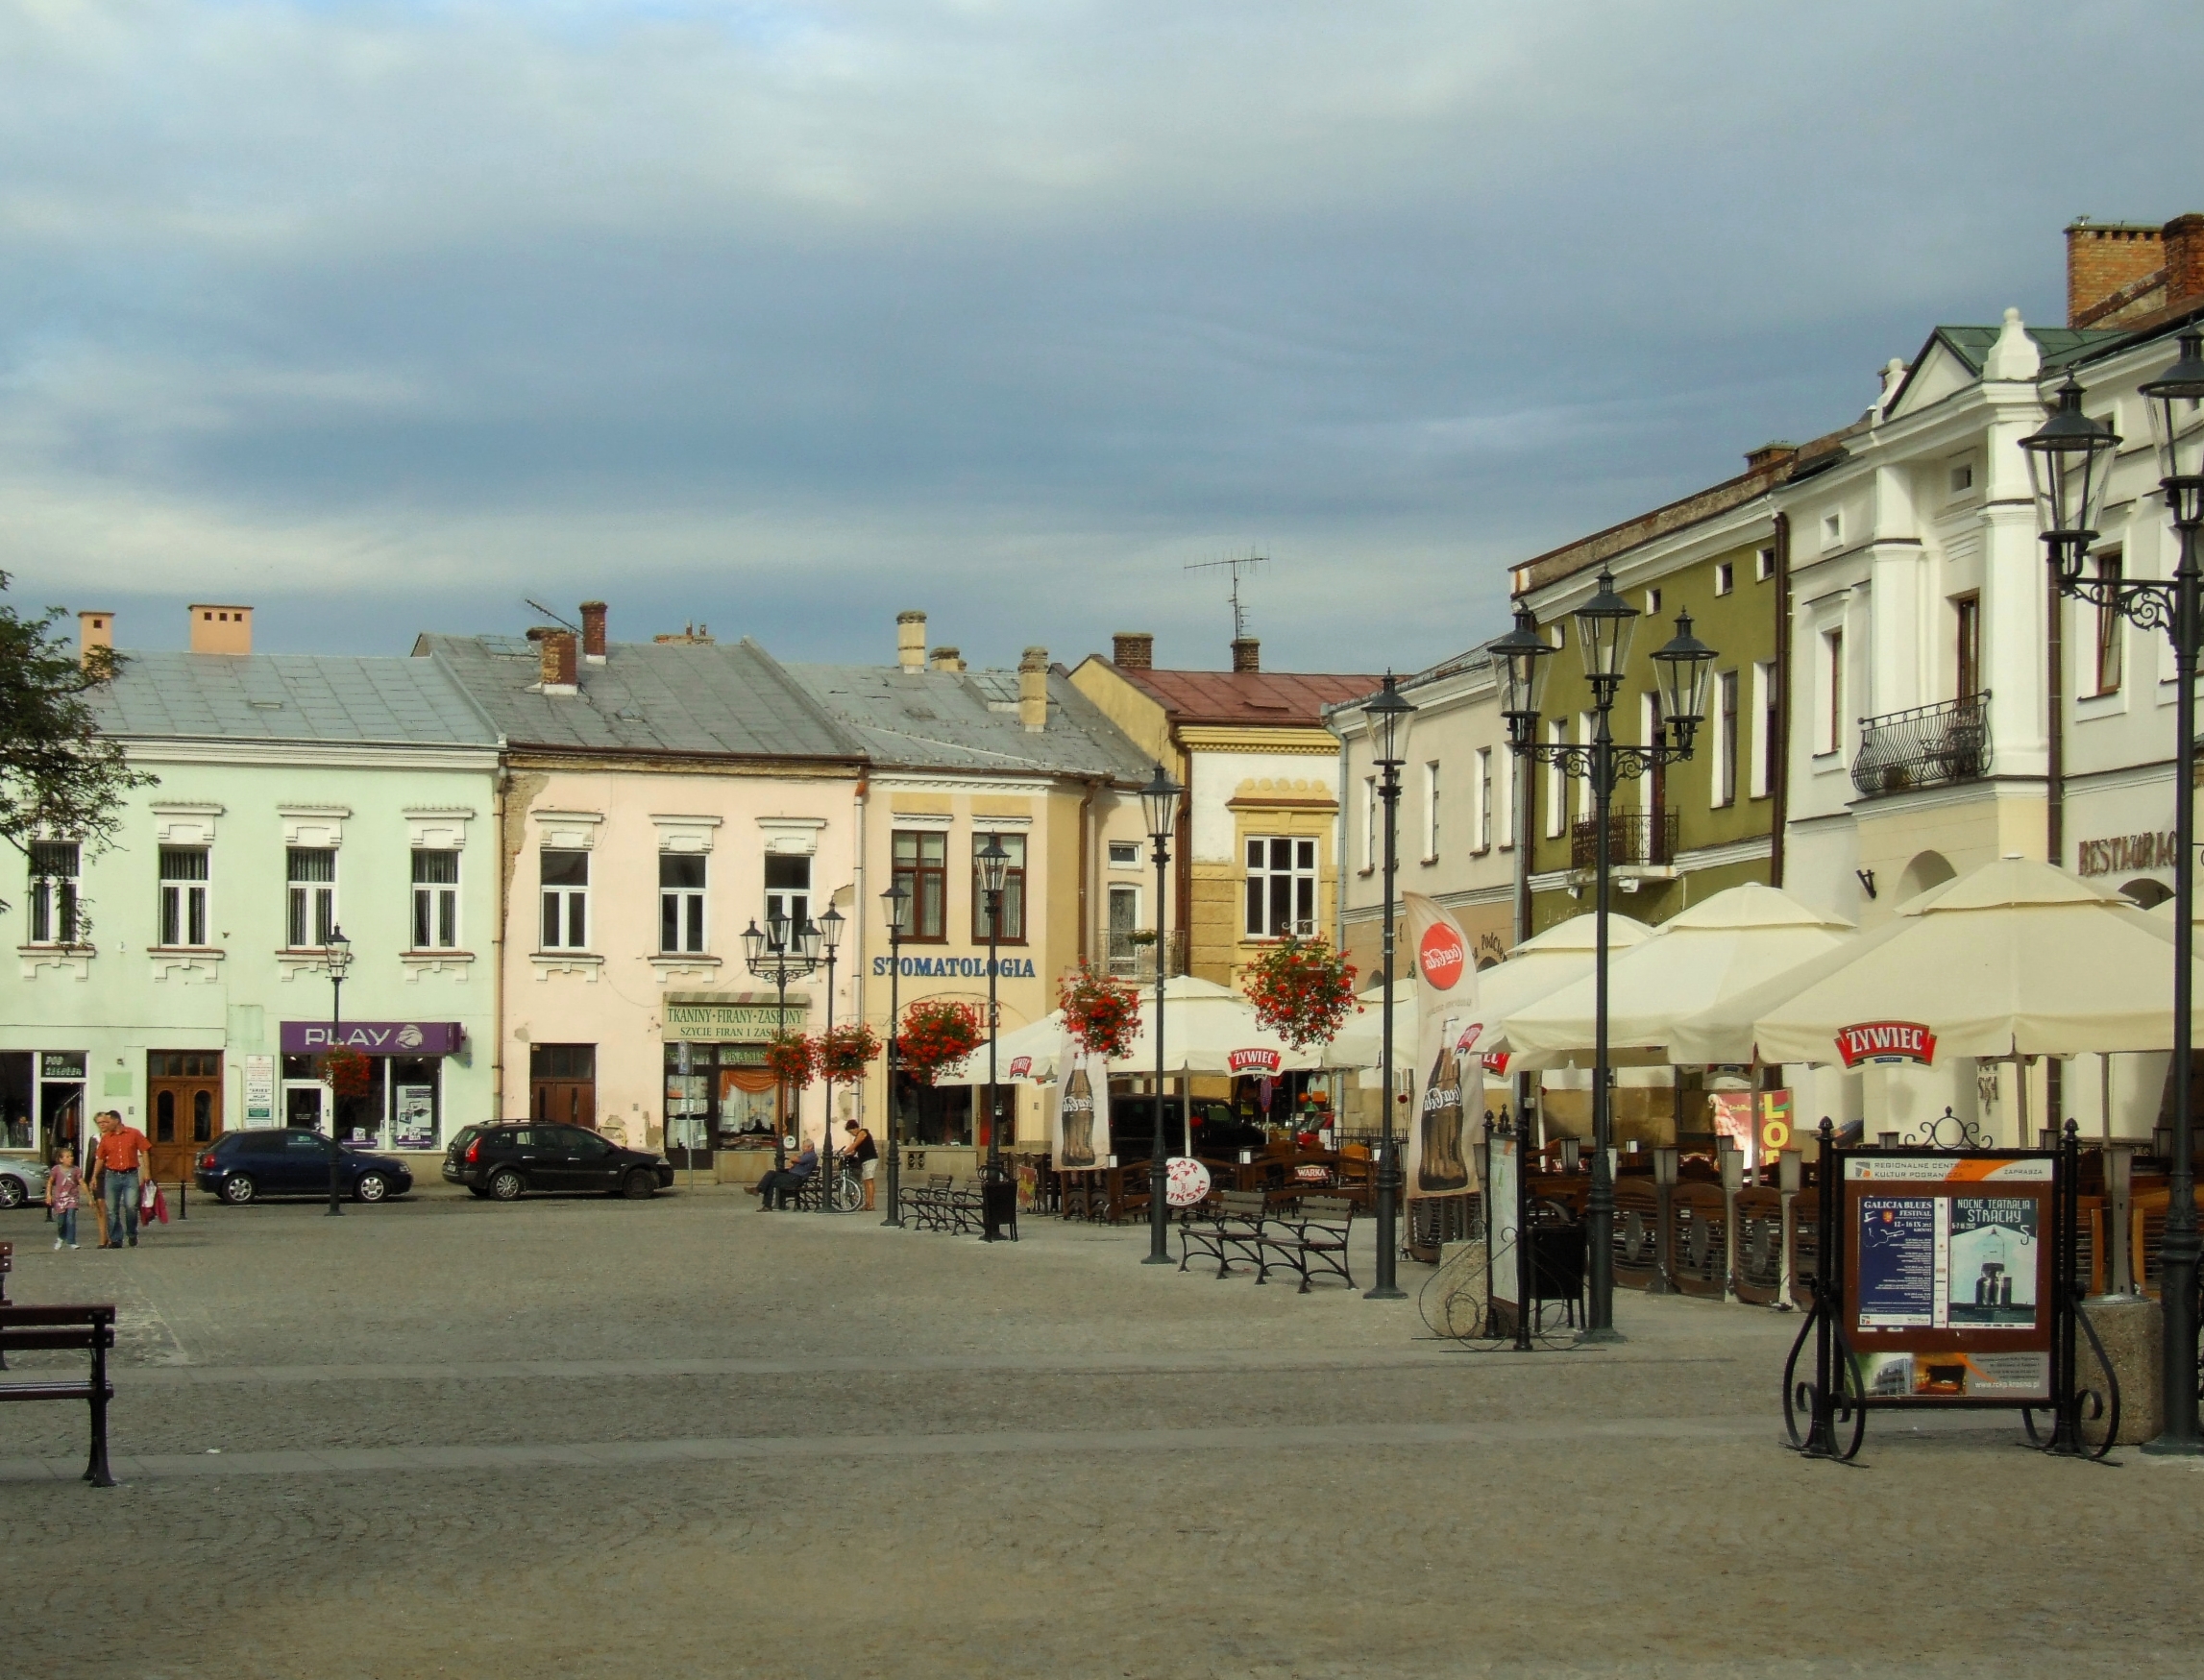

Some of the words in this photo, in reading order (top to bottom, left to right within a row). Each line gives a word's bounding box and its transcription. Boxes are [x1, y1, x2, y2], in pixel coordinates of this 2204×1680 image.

[873, 957, 1036, 978] STOMATOLOGIA
[668, 1008, 712, 1023] TKANINY
[717, 1009, 752, 1024] FIRANY
[305, 1028, 392, 1046] PLAY
[680, 1027, 712, 1036] SZYCIE
[716, 1028, 743, 1036] FIRAN
[1849, 1027, 1922, 1054] ŻYWIEC
[1234, 1049, 1275, 1065] ŻYWIEC
[1297, 1169, 1327, 1178] WARKA
[1864, 1201, 1902, 1209] GALICJA
[1904, 1201, 1932, 1209] BLUES
[1957, 1199, 1984, 1208] NOCNE
[1988, 1199, 2030, 1209] TEATRALIA
[1968, 1209, 2021, 1223] STRACHY
